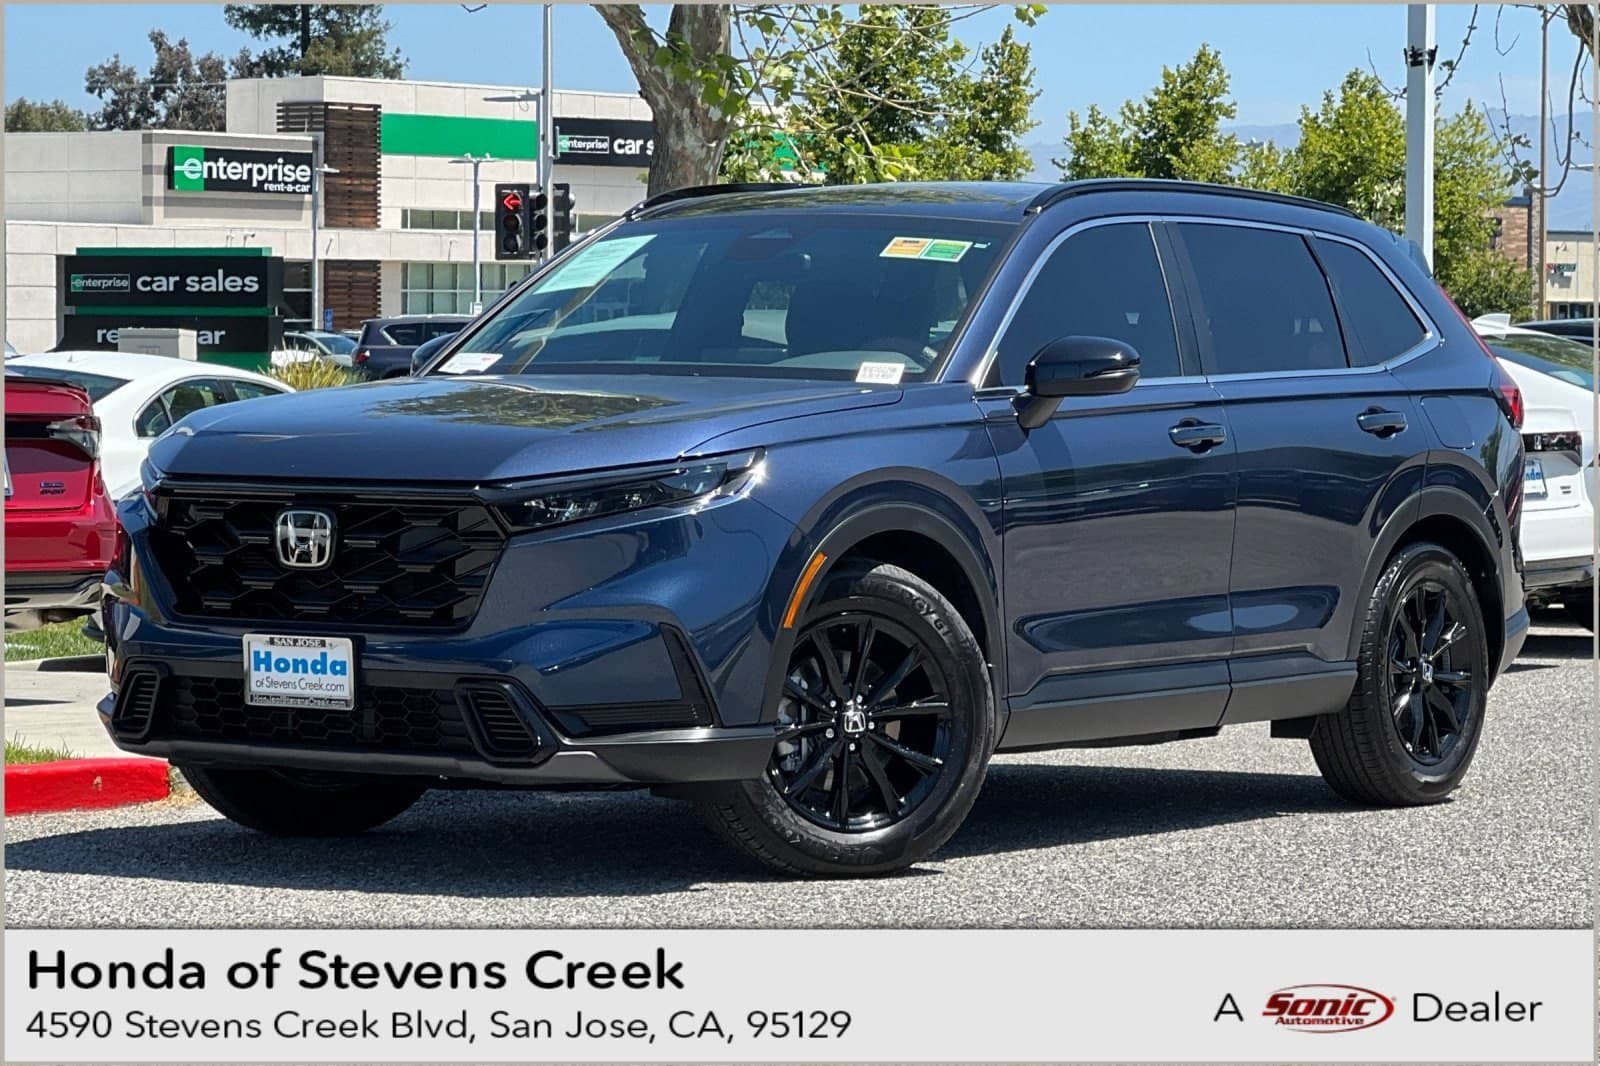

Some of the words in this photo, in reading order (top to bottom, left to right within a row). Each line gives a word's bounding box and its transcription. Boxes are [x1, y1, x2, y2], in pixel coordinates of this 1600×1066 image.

[613, 139, 644, 155] car
[175, 157, 311, 187] enterprise
[264, 183, 311, 193] rent-a-car
[72, 277, 129, 289] enterprise
[136, 275, 180, 292] car
[185, 269, 260, 292] sales
[274, 638, 293, 647] SAN
[296, 639, 321, 649] JOSE
[253, 650, 347, 676] Honda
[255, 678, 264, 689] of
[265, 675, 297, 690] Stevens
